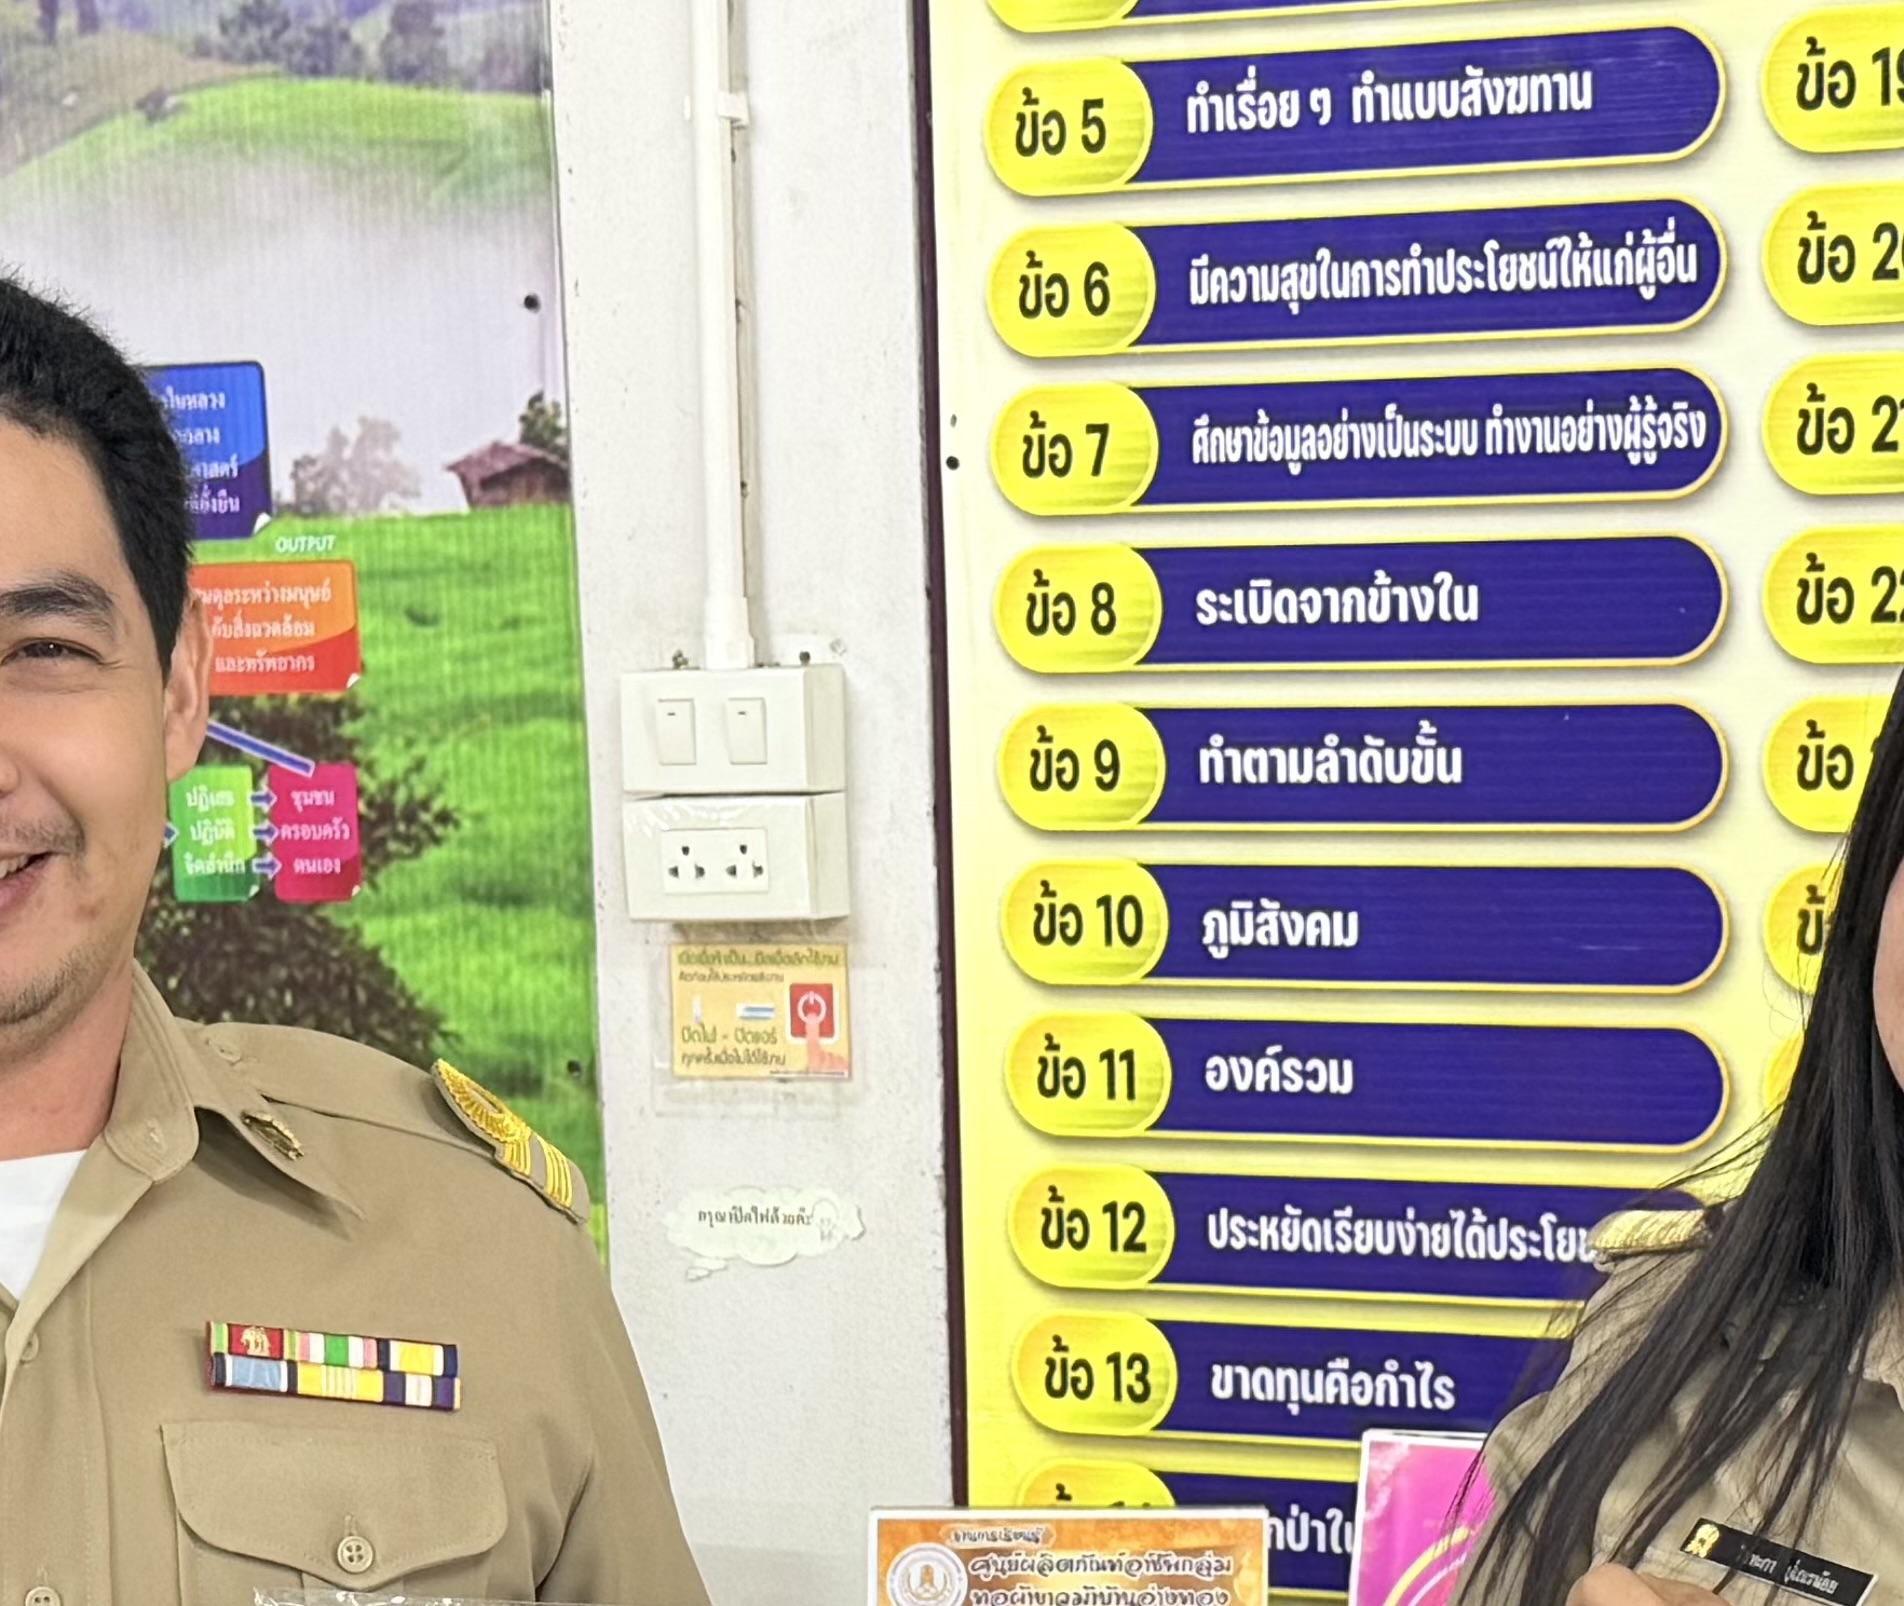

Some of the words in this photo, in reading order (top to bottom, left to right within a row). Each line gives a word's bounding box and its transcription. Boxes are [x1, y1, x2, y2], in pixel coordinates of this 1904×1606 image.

[1014, 88, 1067, 157] ข้อ
[1080, 97, 1107, 154] 5
[1186, 66, 1300, 135] ทำเรื่อย
[1351, 64, 1593, 124] ทำแบบสังฆทาน
[1796, 37, 1857, 112] ข้อ
[1018, 249, 1070, 319] ข้อ
[1083, 262, 1111, 316] 6
[1189, 217, 1698, 316] มีความสุขในการทำประโยชน์ให้แก่ผู้อื่น
[1796, 210, 1857, 285] ข้อ
[1021, 411, 1072, 481] ข้อ
[1084, 423, 1110, 478] 7
[1191, 402, 1479, 476] ศึกษาข้อมูลอย่างเป็นระบบ
[1485, 395, 1708, 467] ทำงานอย่างผู้รู้จริง
[1796, 382, 1852, 457] ข้อ
[274, 534, 337, 555] OUTPUT
[1025, 569, 1077, 637] ข้อ
[1091, 581, 1117, 636] 8
[1196, 571, 1479, 627] ระเบิดจากข้างใน
[1796, 552, 1852, 627] ข้อ
[1029, 725, 1079, 794] ข้อ
[1093, 737, 1121, 792] 9
[1198, 718, 1463, 786] ทำตามลำดับขั้น
[1796, 719, 1853, 793] ข้อ
[1033, 880, 1083, 949] ข้อ
[1096, 894, 1144, 949] 10
[1202, 900, 1359, 962] ภูมิสังคม
[1037, 1032, 1086, 1101] ข้อ
[1098, 1047, 1137, 1102] 11
[1205, 1046, 1354, 1096] องค์รวม
[1041, 1185, 1090, 1253] ข้อ
[1102, 1199, 1148, 1254] 12
[1044, 1335, 1094, 1403] ข้อ
[1106, 1352, 1152, 1403] 13
[1211, 1360, 1455, 1418] ขาดทุนคือกำไร
